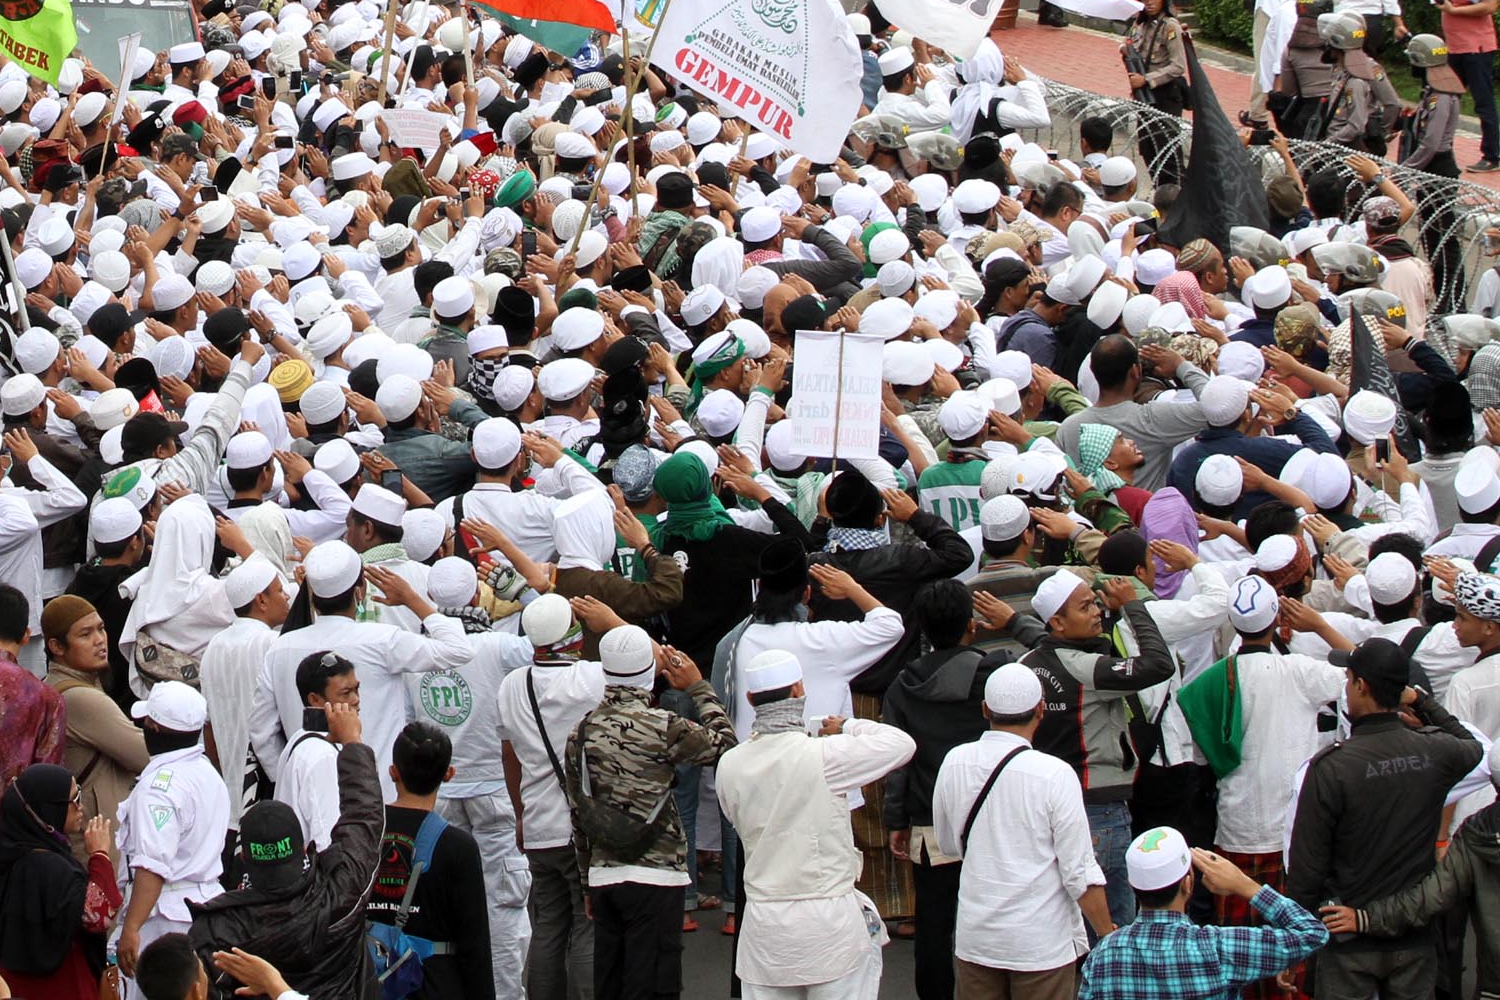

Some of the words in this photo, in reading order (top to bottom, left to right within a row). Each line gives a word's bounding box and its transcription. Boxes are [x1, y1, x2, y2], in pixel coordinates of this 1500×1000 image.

[697, 31, 736, 59] PEMBELA
[735, 54, 759, 73] UMAT
[712, 28, 761, 63] GERAKAN
[674, 47, 794, 141] GEMPUR
[430, 686, 461, 707] FPI
[1049, 675, 1066, 694] CITY
